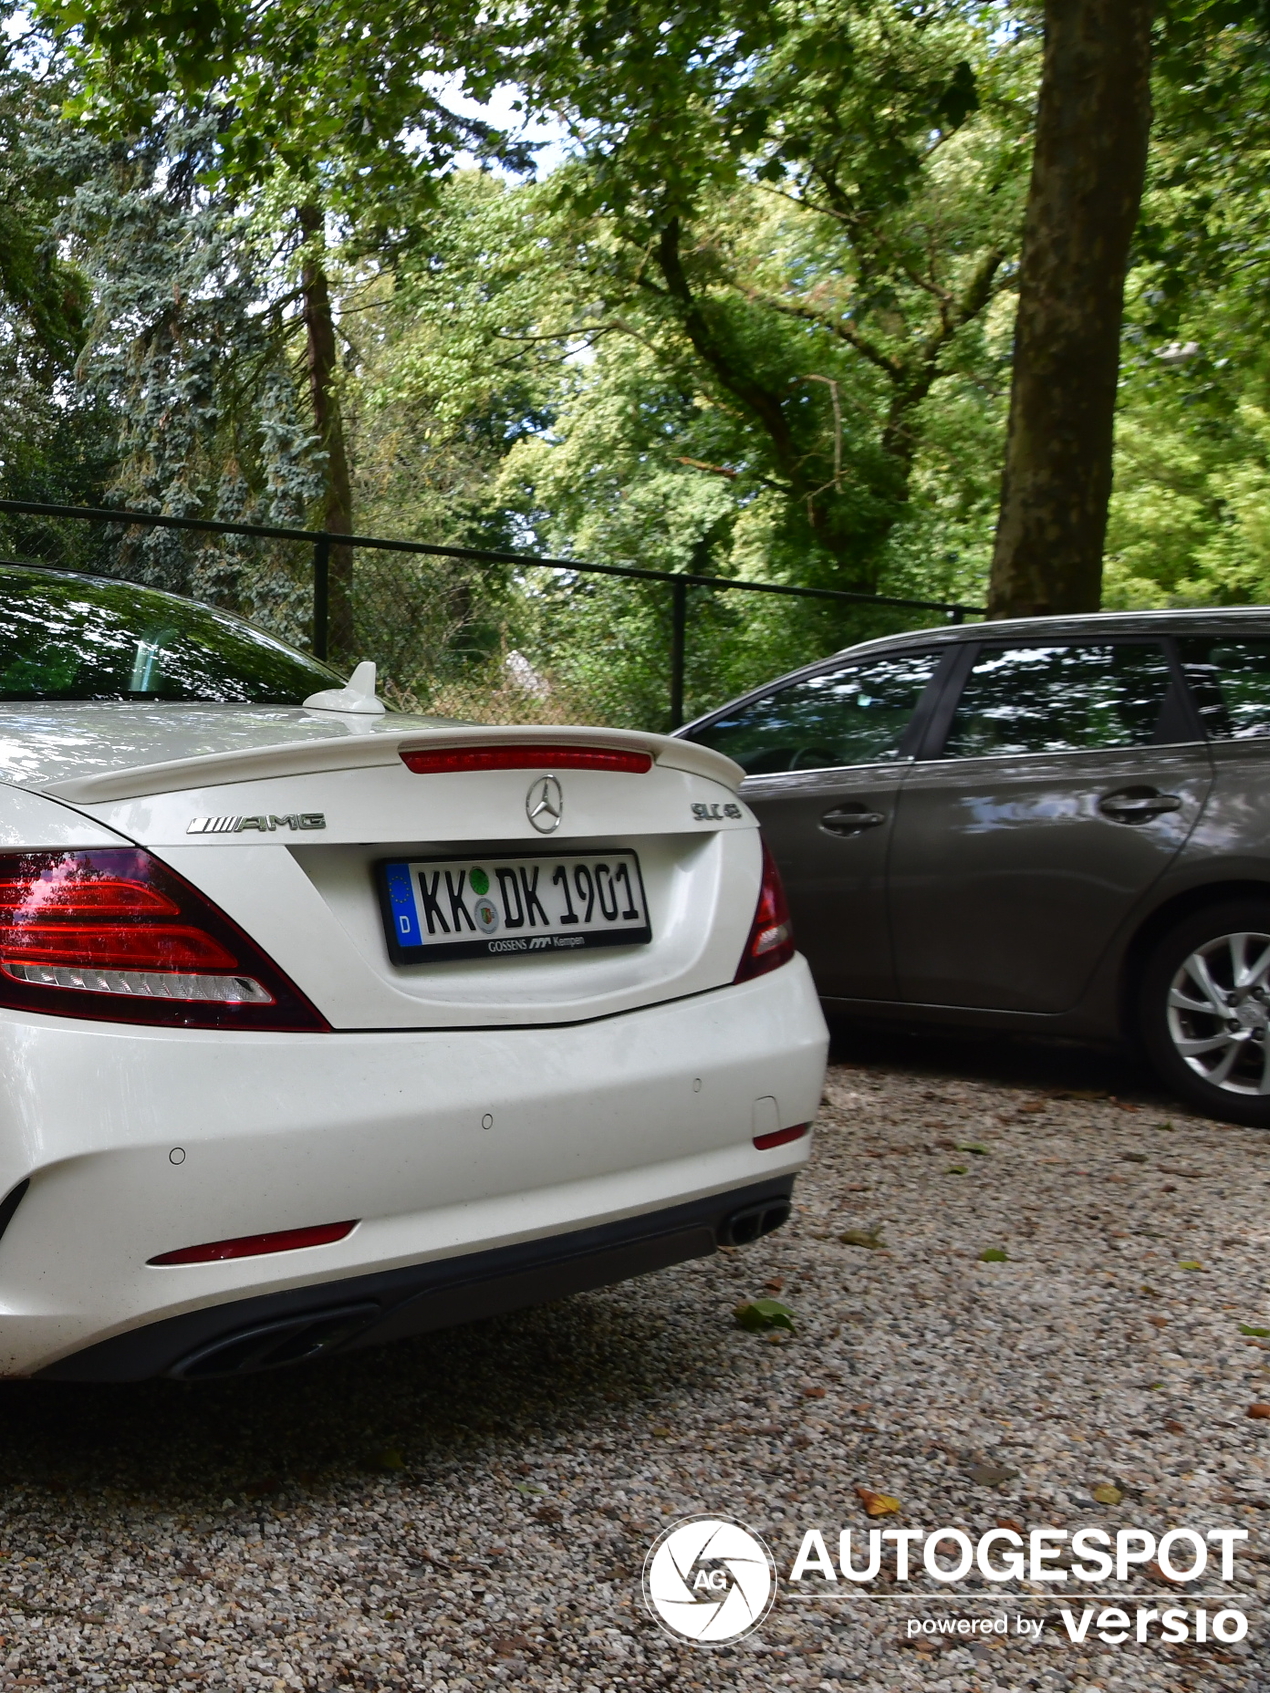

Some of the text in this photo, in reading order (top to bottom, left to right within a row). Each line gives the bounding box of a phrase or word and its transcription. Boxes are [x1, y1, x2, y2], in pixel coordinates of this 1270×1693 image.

[233, 813, 327, 832] AMG
[417, 862, 639, 934] KK DK 1901
[399, 915, 411, 934] D
[488, 936, 585, 953] GOSSENS Kempen
